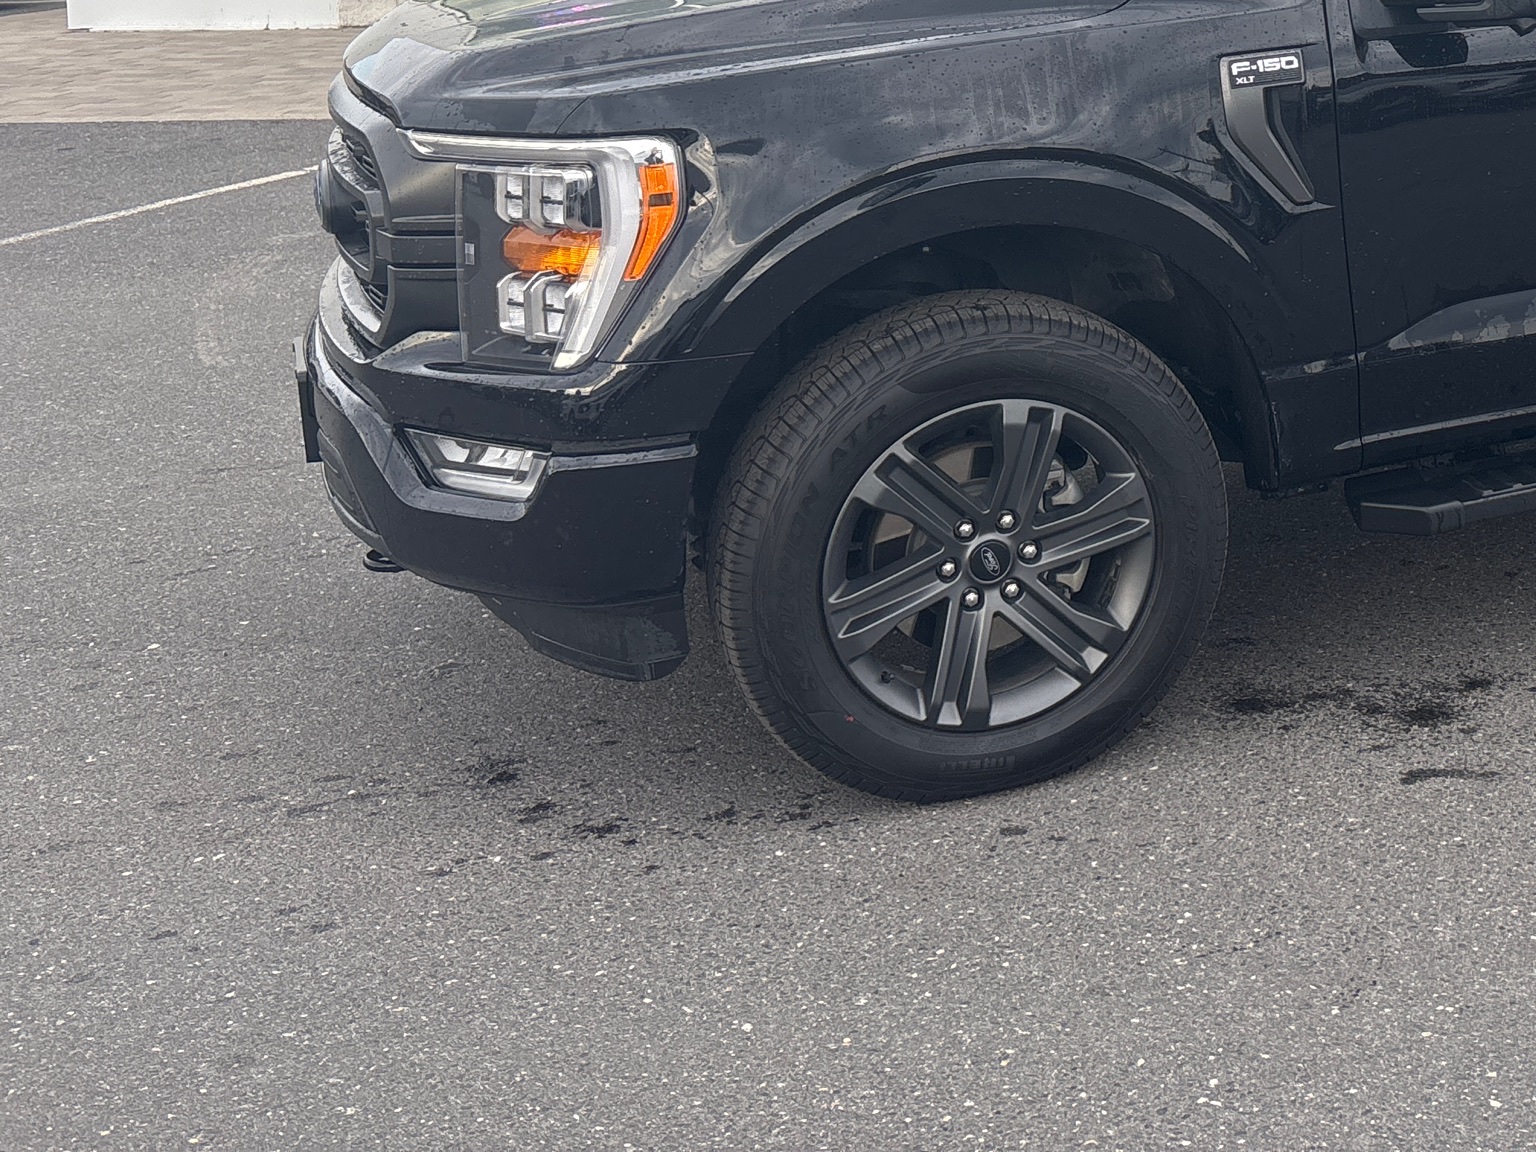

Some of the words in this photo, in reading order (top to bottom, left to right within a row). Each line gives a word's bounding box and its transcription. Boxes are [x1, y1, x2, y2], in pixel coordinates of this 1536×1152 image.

[1230, 55, 1300, 76] F-150
[1235, 75, 1256, 86] XLT
[829, 402, 889, 474] ATR
